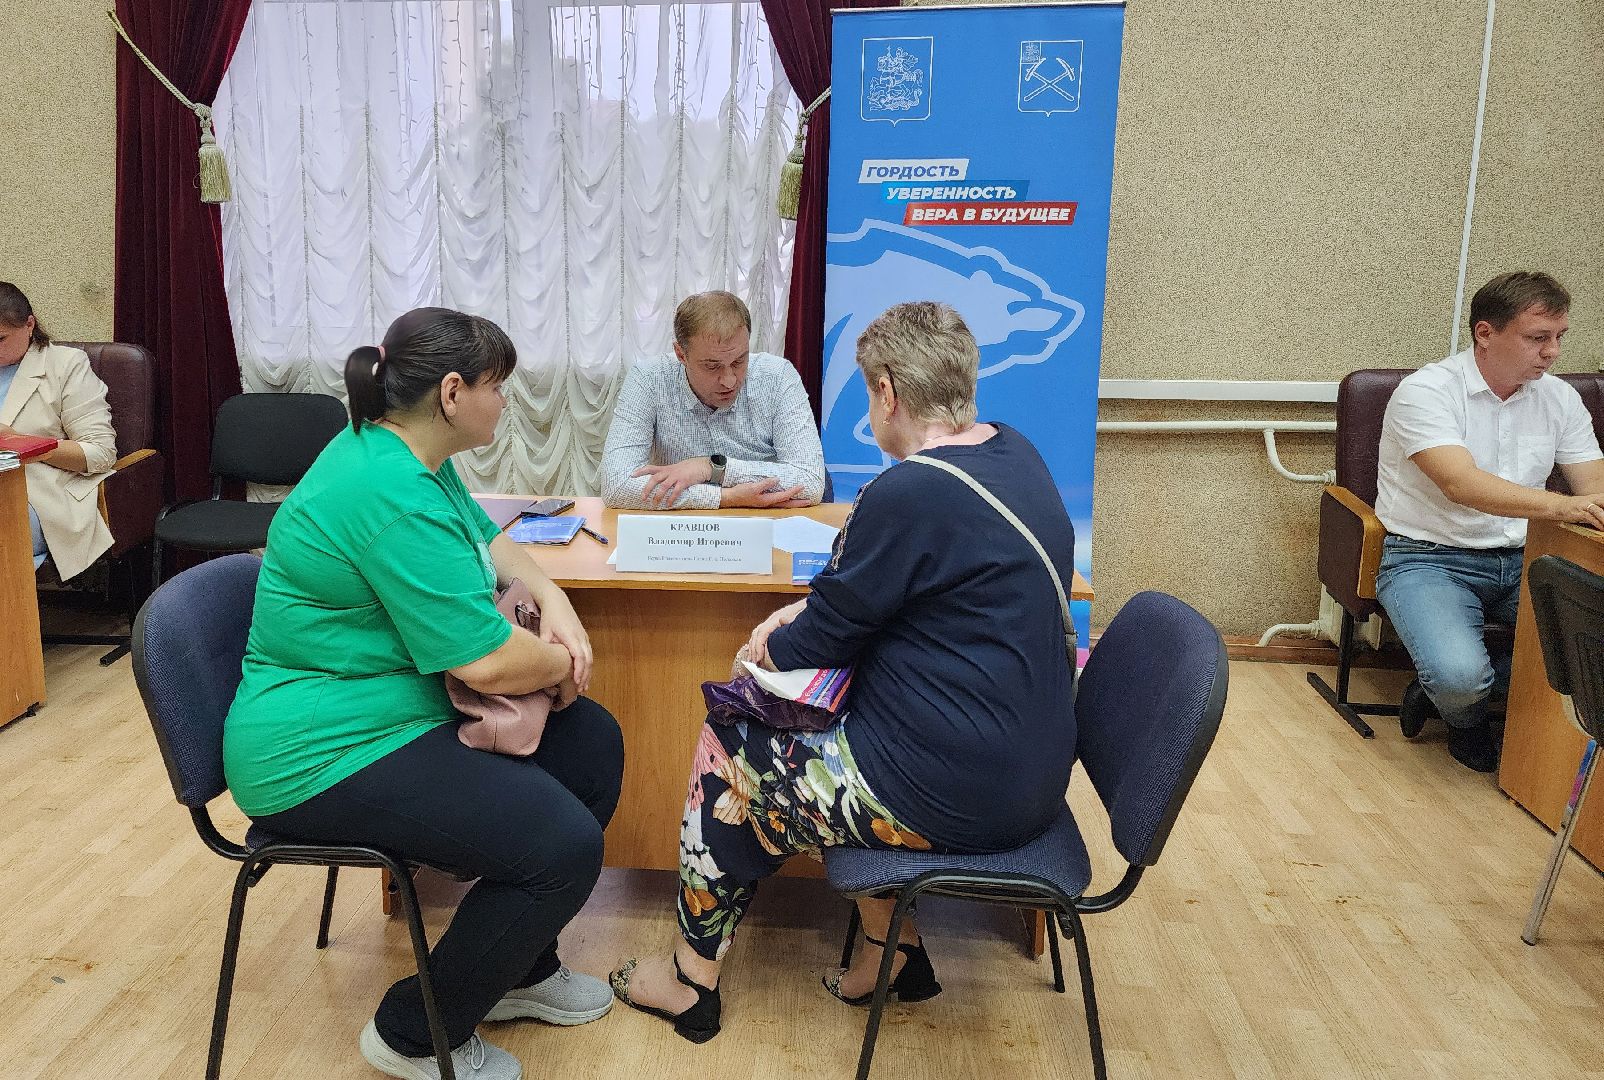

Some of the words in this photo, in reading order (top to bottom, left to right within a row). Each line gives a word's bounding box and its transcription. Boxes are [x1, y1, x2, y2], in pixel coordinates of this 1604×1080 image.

[866, 166, 960, 180] ГОРДОСТЬ
[886, 186, 1017, 200] УВЕРЕННОСТЬ
[911, 208, 958, 221] ВЕРА
[962, 208, 977, 221] В
[980, 208, 1071, 223] БУДУЩЕЕ
[670, 523, 720, 532] КРАВЦОВ
[648, 536, 695, 547] Владимир
[697, 537, 742, 548] Игоревич
